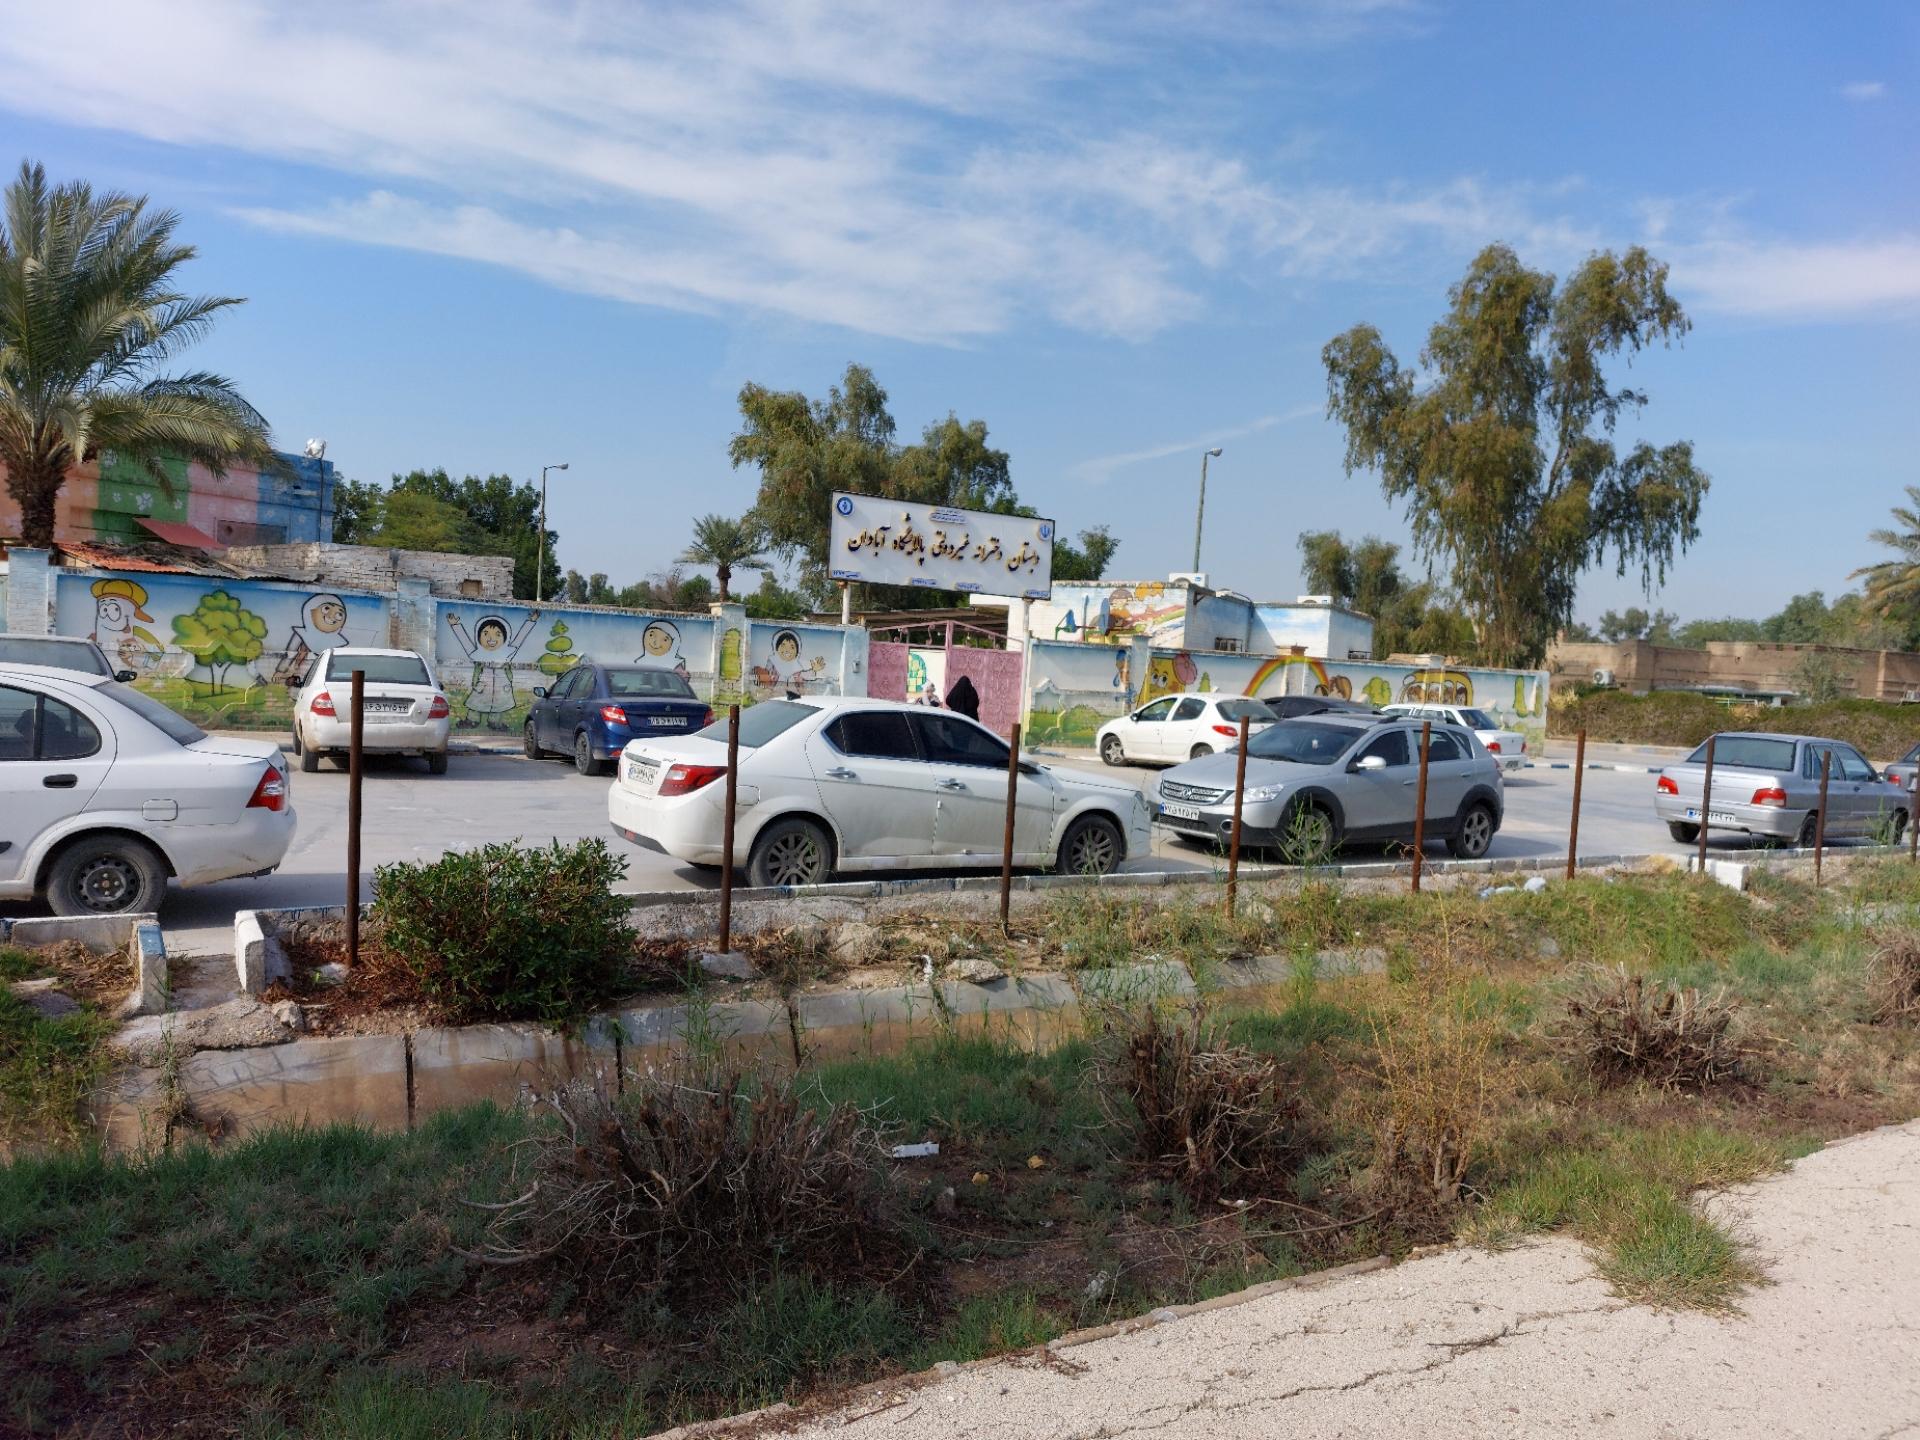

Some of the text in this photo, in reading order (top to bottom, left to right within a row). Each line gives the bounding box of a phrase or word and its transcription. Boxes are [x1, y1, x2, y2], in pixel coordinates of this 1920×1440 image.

[847, 513, 1041, 574] دبستان دخترانه غیردولتی پالایشگاه آبادان
